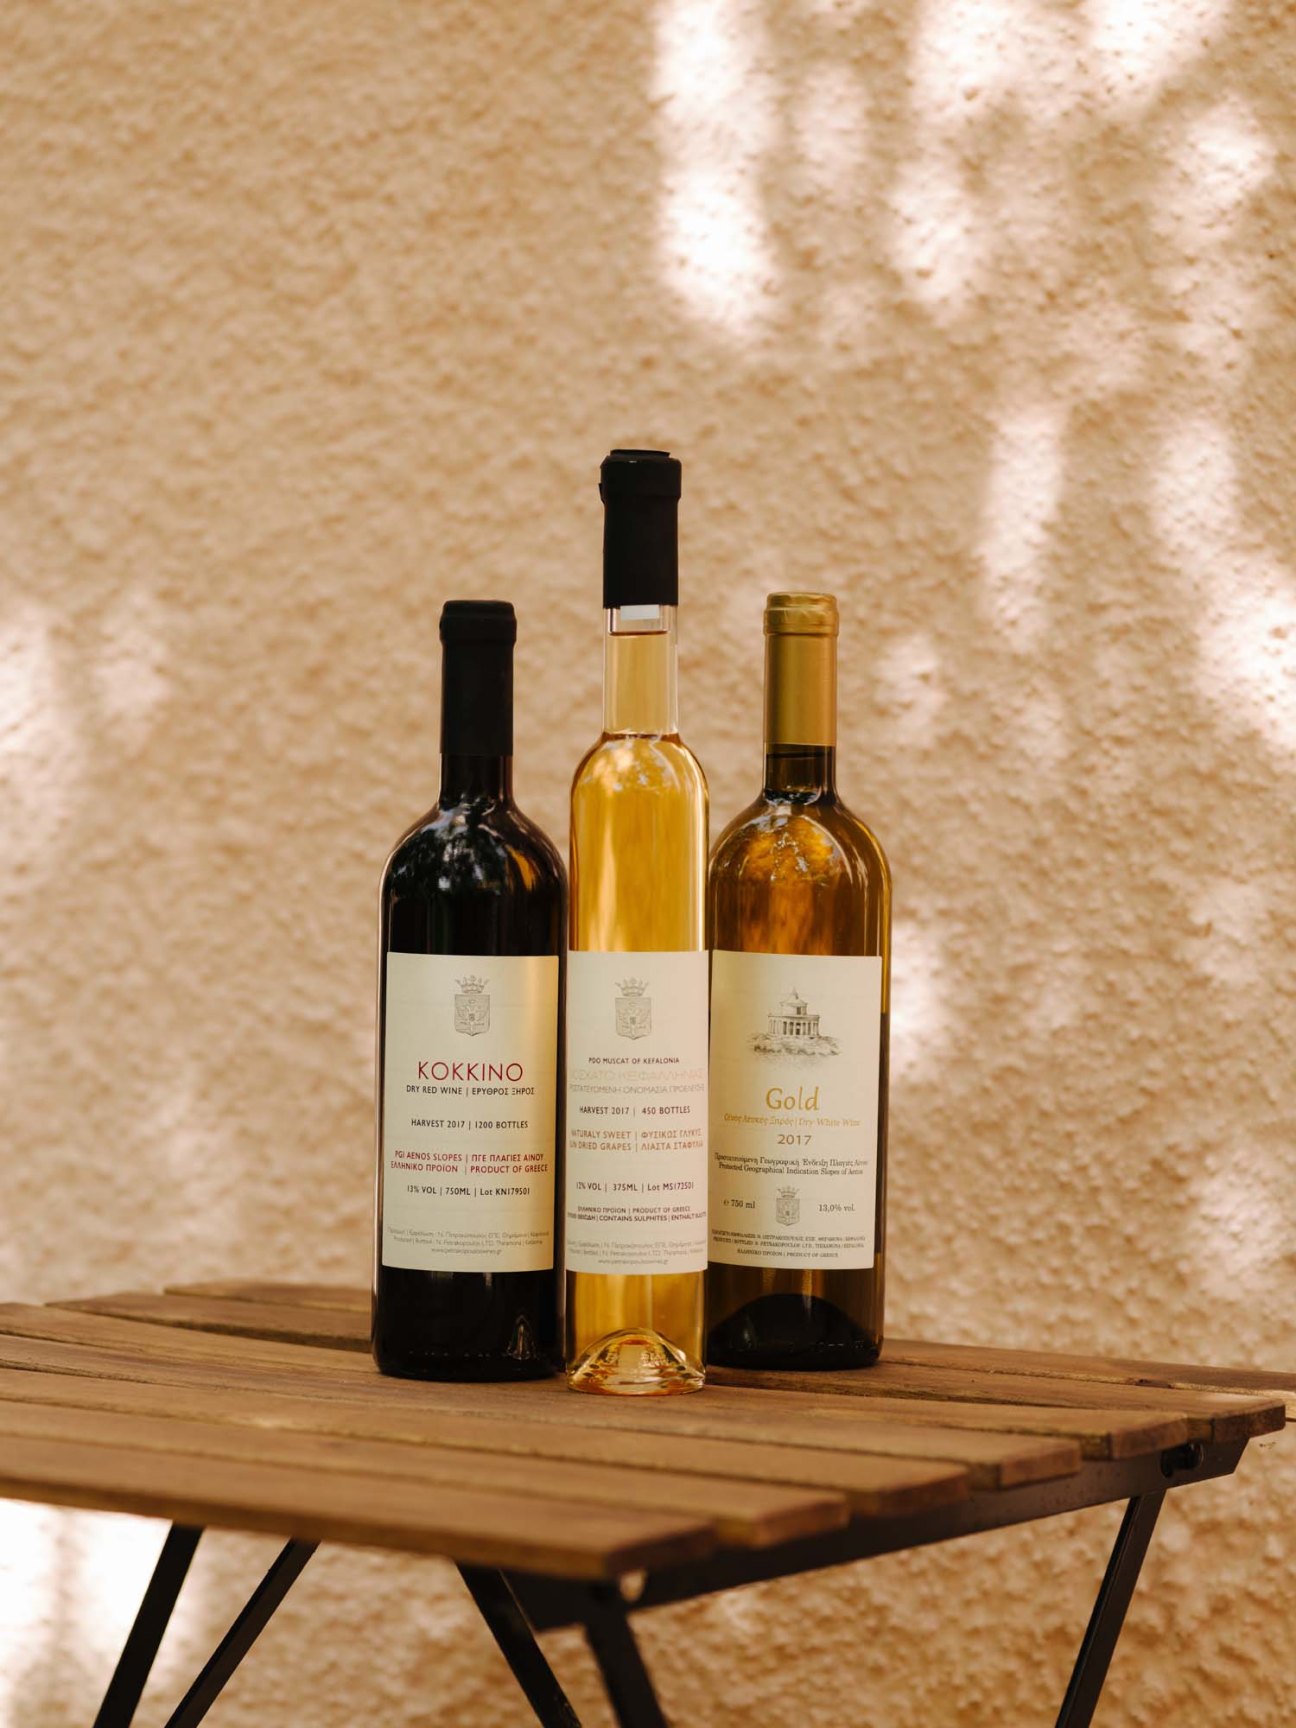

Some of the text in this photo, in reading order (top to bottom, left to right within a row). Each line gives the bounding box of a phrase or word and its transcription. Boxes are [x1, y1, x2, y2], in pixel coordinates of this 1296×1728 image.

[419, 1062, 523, 1082] KOKKINO
[407, 1085, 535, 1096] DRY RED WINE ΕΡΥΘΡΟΣ ΞΗΡΟΣ
[766, 1086, 820, 1111] Gold
[580, 1106, 608, 1114] HARVEST
[642, 1106, 656, 1114] 450
[659, 1106, 690, 1114] BOTTLES
[411, 1119, 529, 1129] HARVEST 2017 1200 BOTTLES
[603, 1131, 631, 1139] SWEET
[778, 1134, 812, 1145] 2017
[601, 1142, 631, 1151] GRAPES
[407, 1152, 431, 1160] AENOS
[433, 1153, 462, 1161] SLOPES
[471, 1165, 509, 1173] PRODUCT
[513, 1165, 522, 1173] OF
[525, 1164, 548, 1172] GREECE
[407, 1185, 419, 1193] 13%
[422, 1186, 437, 1194] VOL
[588, 1183, 602, 1191] VOL
[746, 1201, 756, 1209] ml
